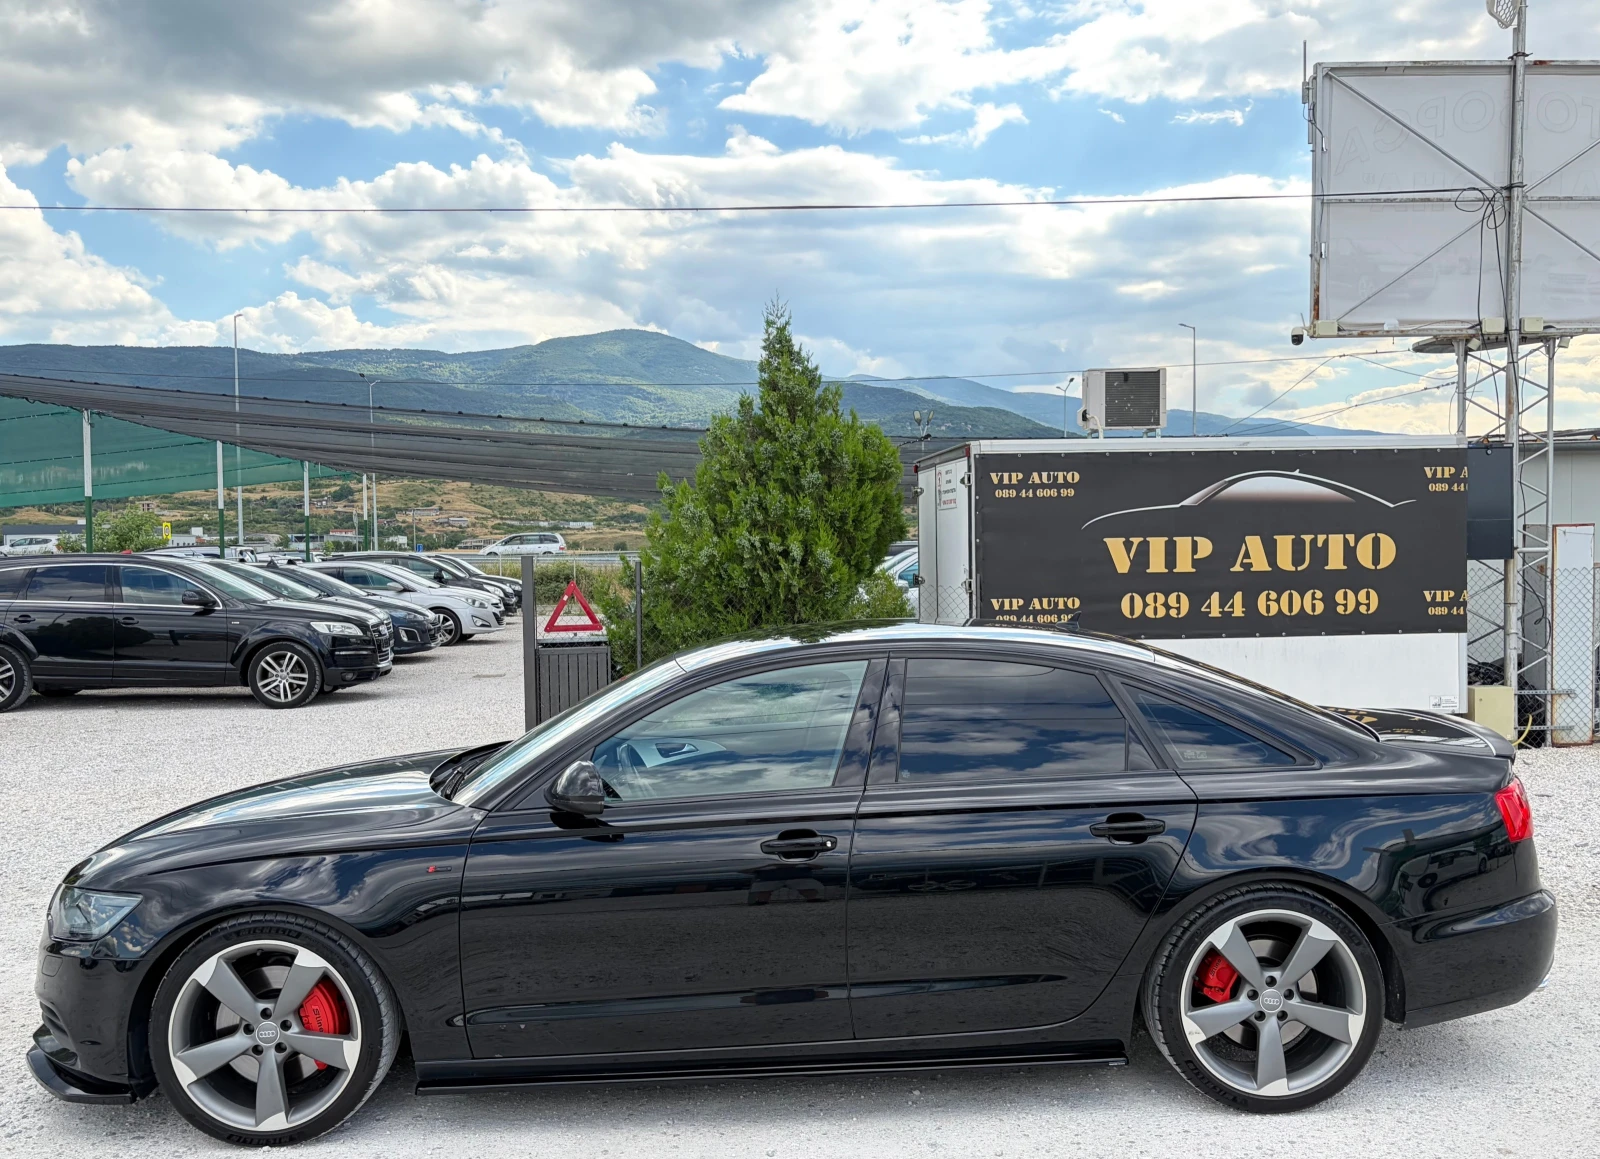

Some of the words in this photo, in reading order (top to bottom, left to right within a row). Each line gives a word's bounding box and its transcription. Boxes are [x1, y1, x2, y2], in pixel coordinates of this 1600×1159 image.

[990, 472, 1024, 485] VIP
[1028, 471, 1081, 485] AUTO
[1423, 466, 1456, 479] VIP
[995, 489, 1017, 498] 089
[1019, 489, 1034, 498] 44
[1037, 489, 1058, 498] 606
[1060, 488, 1075, 498] 99
[1428, 483, 1449, 492] 089
[1451, 483, 1465, 492] 44
[1103, 537, 1213, 574] VIP
[1230, 532, 1397, 572] AUTO
[1423, 590, 1455, 602] VIP
[990, 598, 1024, 611] VIP
[1028, 596, 1081, 610] AUTO
[1120, 592, 1190, 619] 089
[1201, 591, 1246, 618] 44
[1257, 590, 1325, 617] 606
[1335, 588, 1379, 616] 99
[1428, 606, 1448, 615] 089
[1450, 606, 1465, 615] 44
[1019, 614, 1034, 623] 44
[1037, 614, 1058, 623] 606
